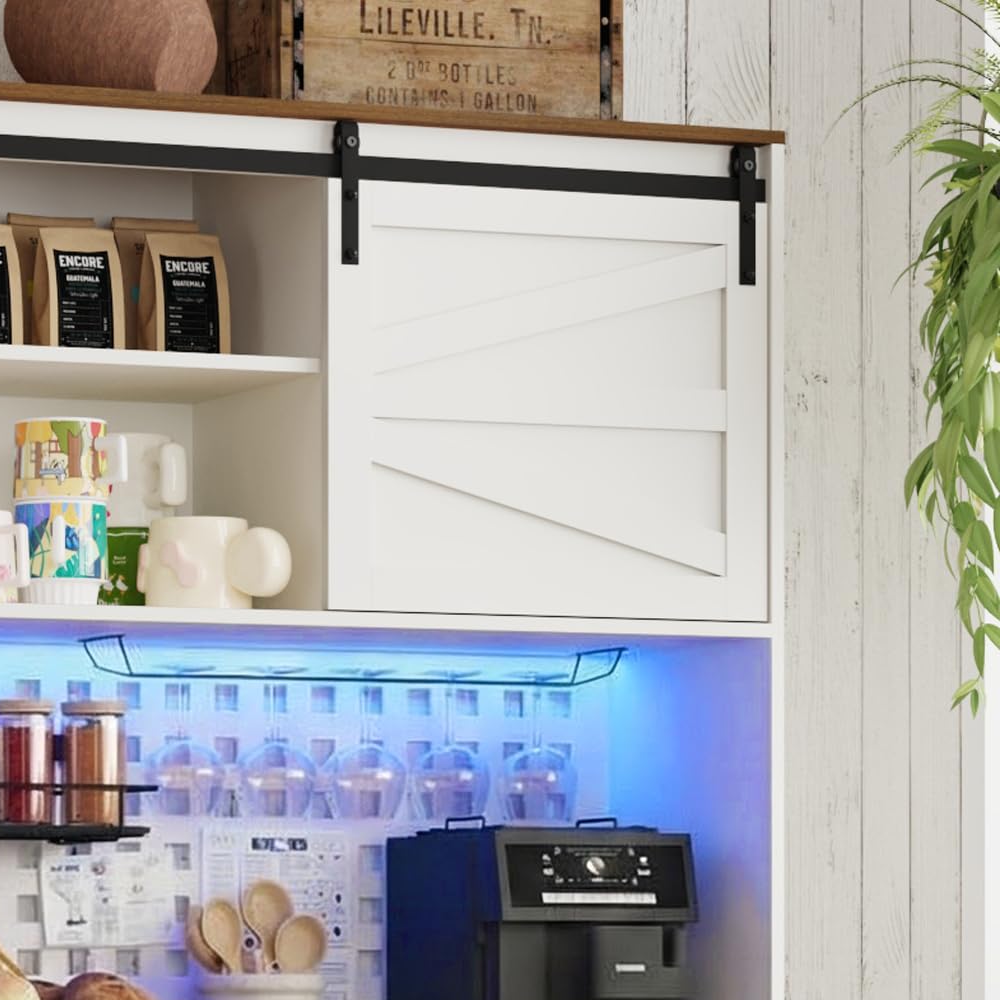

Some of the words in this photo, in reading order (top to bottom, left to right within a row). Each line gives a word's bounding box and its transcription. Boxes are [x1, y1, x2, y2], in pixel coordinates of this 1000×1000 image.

[439, 63, 517, 86] BOTTLES
[366, 86, 449, 107] CONTAINS
[474, 91, 537, 112] GALLON
[58, 254, 105, 269] ENCORE
[165, 260, 211, 274] ENCORE
[66, 274, 100, 283] GUATEMALA
[172, 279, 206, 288] GUATEMALA
